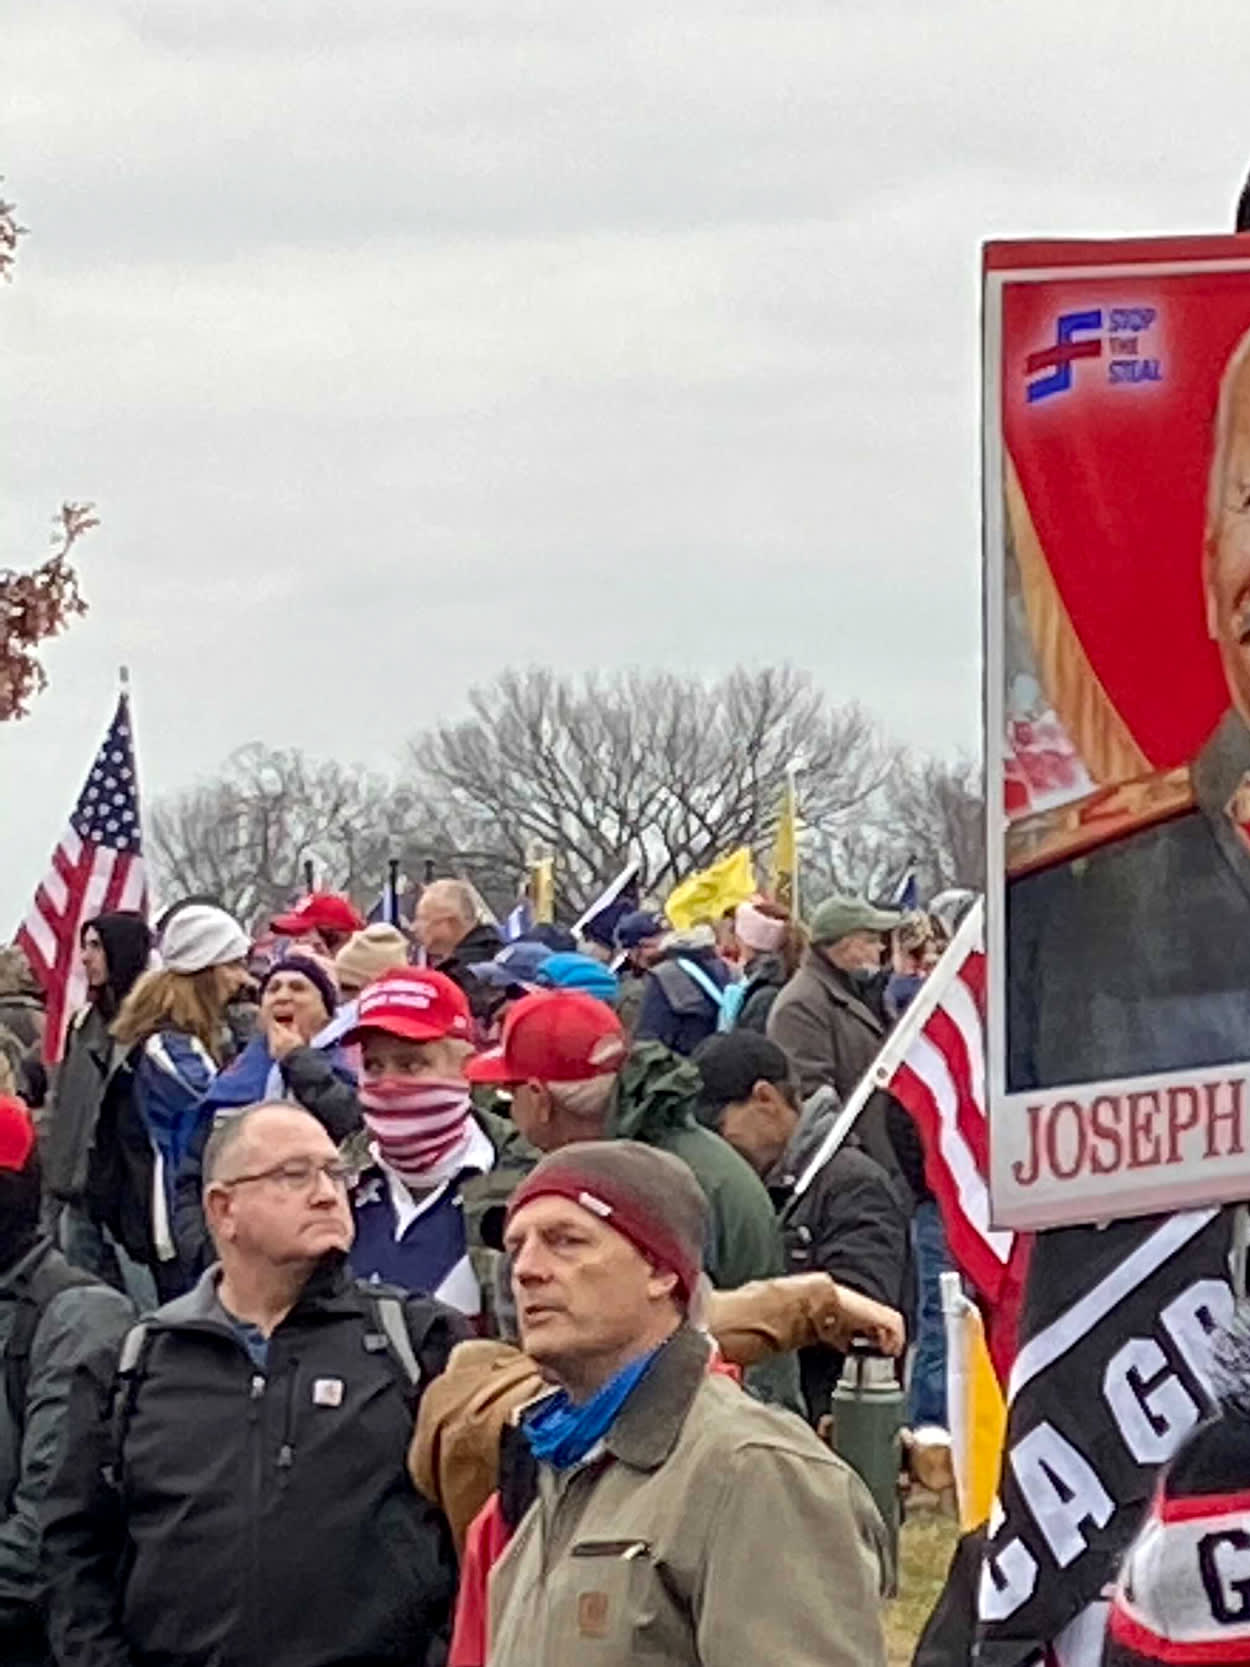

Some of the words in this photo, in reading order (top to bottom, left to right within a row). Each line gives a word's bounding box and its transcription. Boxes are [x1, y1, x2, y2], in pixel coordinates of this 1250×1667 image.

[1109, 308, 1155, 331] STOP
[1109, 336, 1138, 355] THE
[1109, 359, 1162, 383] STEAL
[1012, 1079, 1246, 1186] JOSEPH
